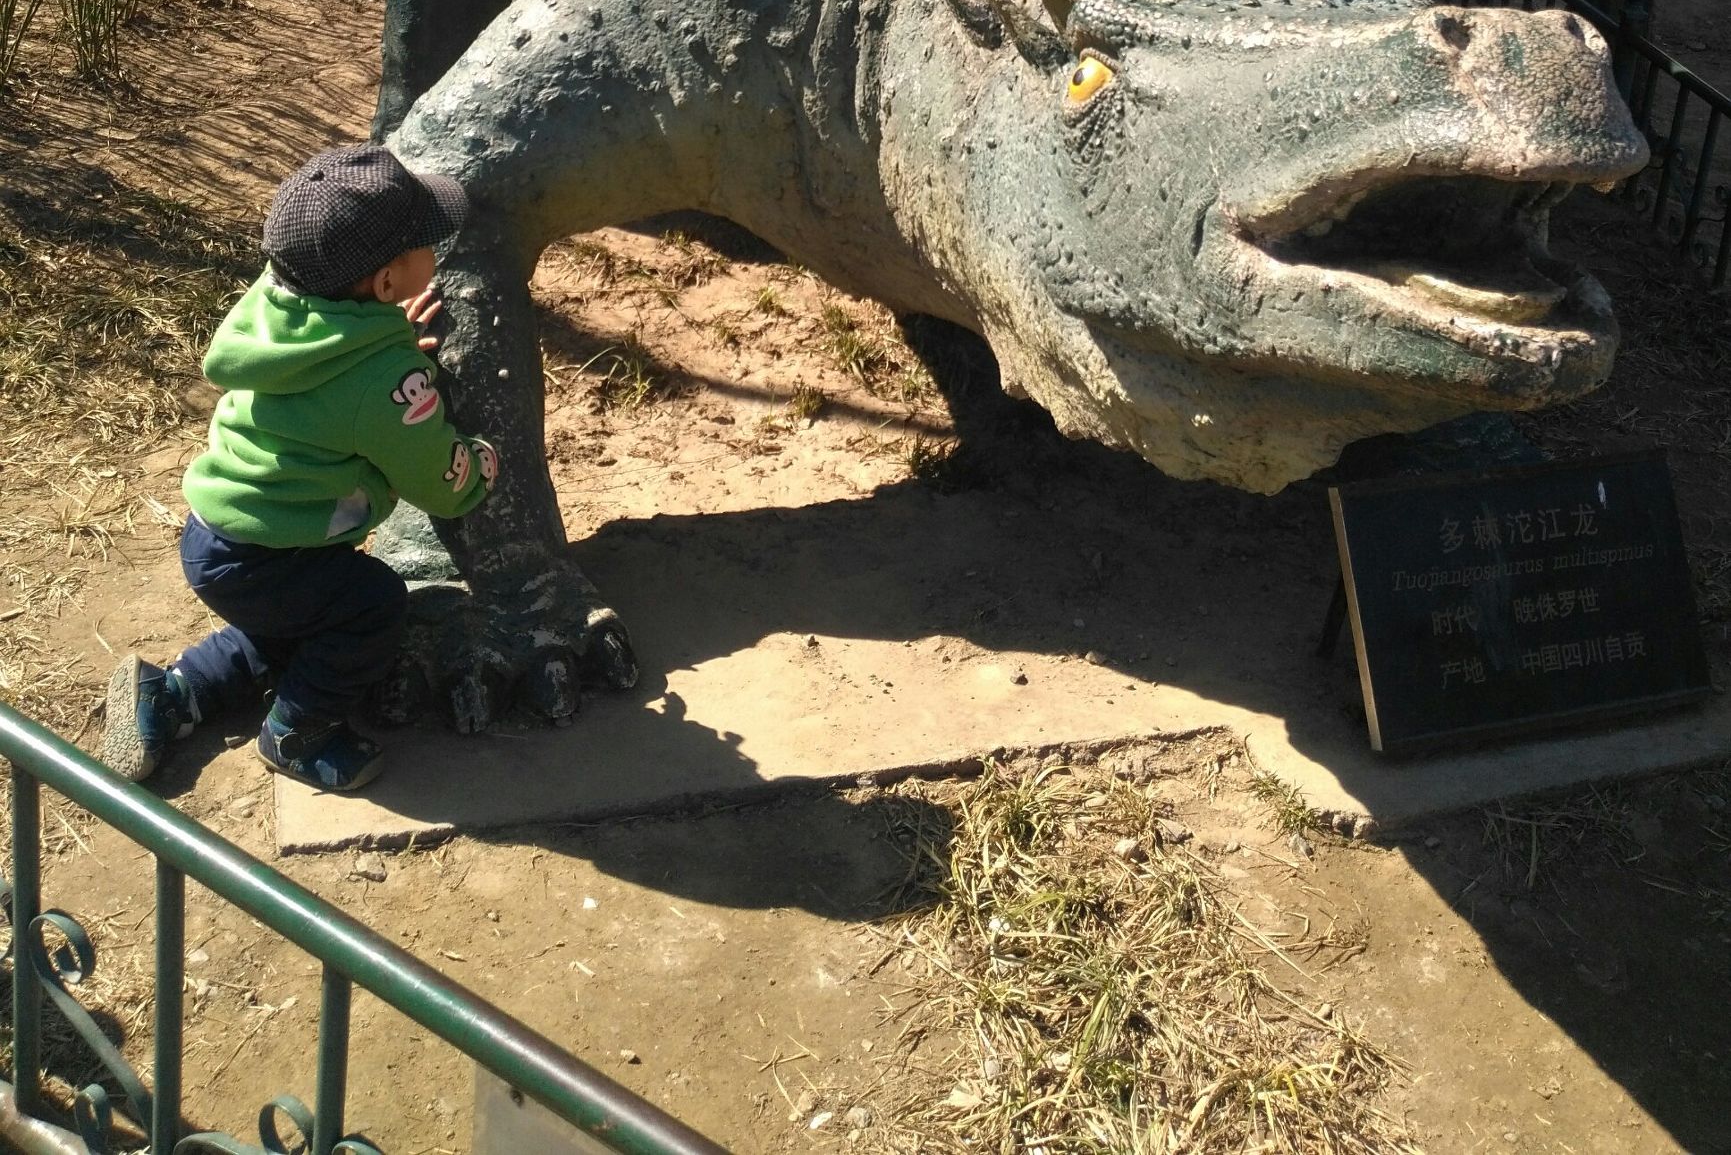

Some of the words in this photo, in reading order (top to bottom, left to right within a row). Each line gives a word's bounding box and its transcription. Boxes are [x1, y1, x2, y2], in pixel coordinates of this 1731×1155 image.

[1440, 504, 1599, 553] 多棘沱江龙
[1431, 604, 1479, 636] 时代
[1513, 588, 1599, 625] 晚侏罗世
[1440, 658, 1486, 690] 产地
[1521, 630, 1647, 677] 中国四川自贡
